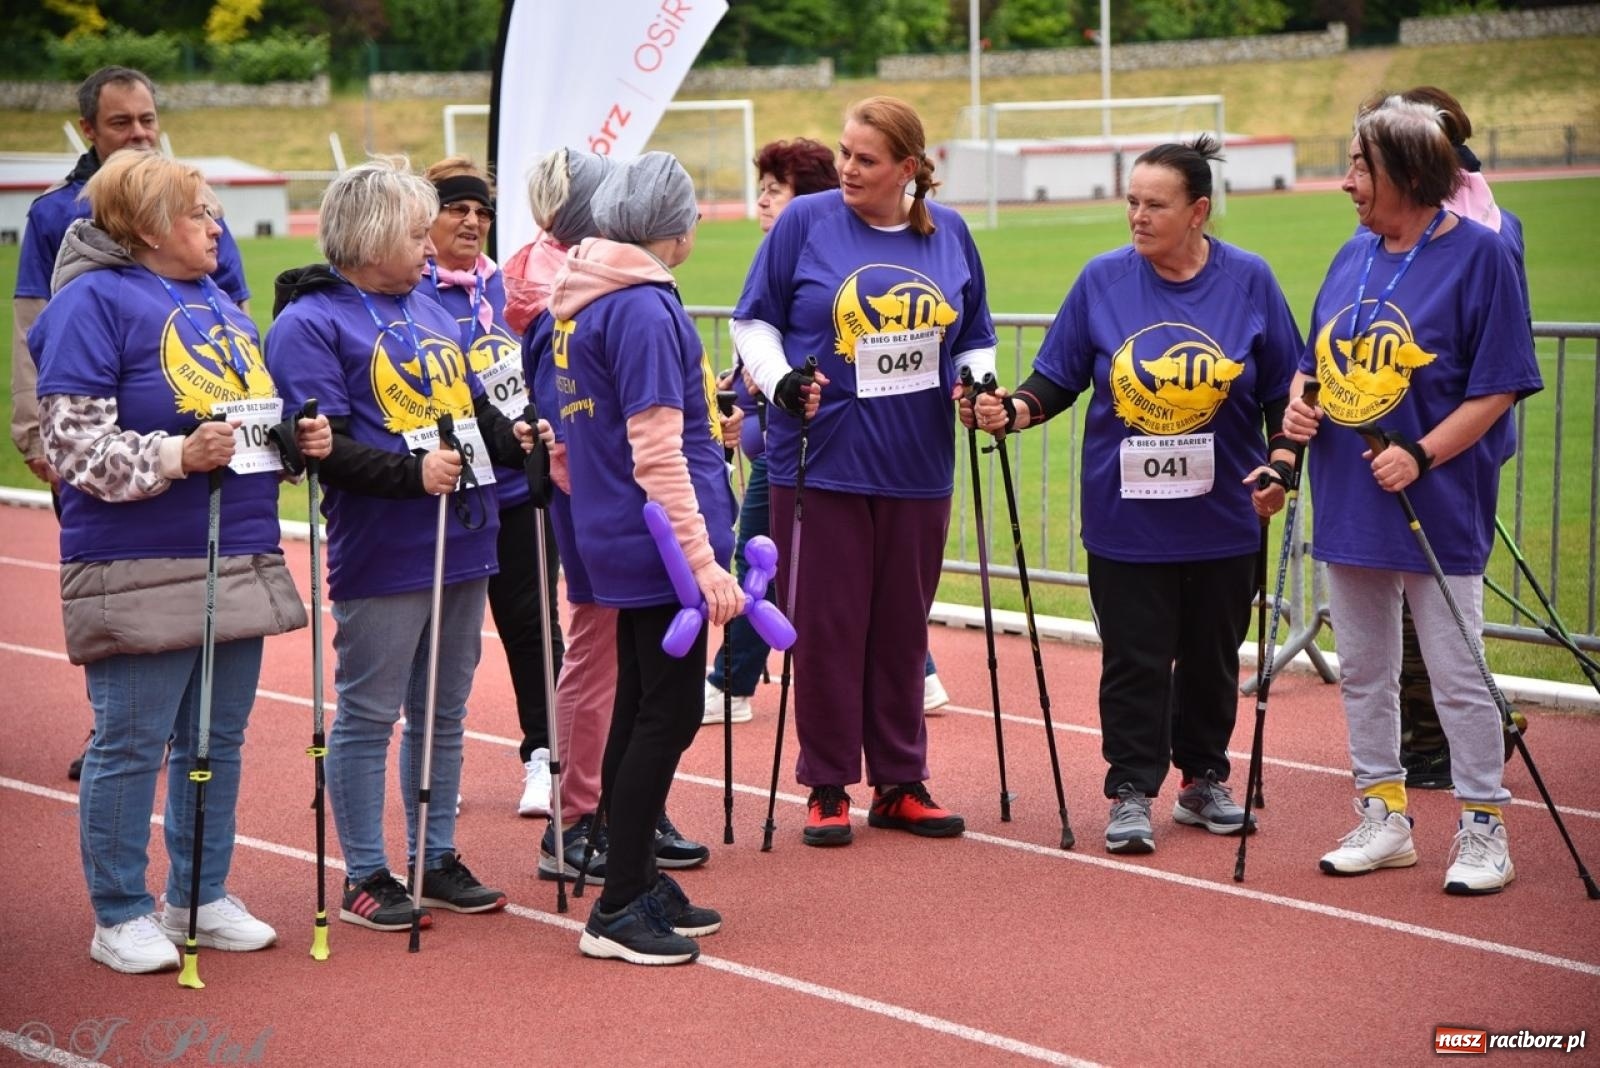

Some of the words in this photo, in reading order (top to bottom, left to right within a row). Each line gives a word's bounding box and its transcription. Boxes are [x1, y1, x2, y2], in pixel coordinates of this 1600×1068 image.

[588, 104, 632, 155] órz
[634, 0, 693, 72] OSiR
[896, 292, 937, 329] 10
[871, 336, 890, 344] BIEG
[893, 334, 907, 342] BEZ
[910, 332, 935, 341] BARIER
[877, 351, 923, 374] 049
[1365, 333, 1400, 372] 10
[1173, 353, 1215, 389] 10
[1319, 355, 1361, 406] RACIBORSKI
[494, 371, 525, 401] 02
[1117, 375, 1174, 420] RACIBORSKI
[227, 404, 245, 414] BIEG
[1346, 408, 1358, 418] BEZ
[240, 424, 270, 448] 105
[1145, 418, 1160, 431] BIEG
[1161, 421, 1175, 432] BEZ
[1137, 440, 1157, 448] BIEG
[1159, 439, 1175, 447] BEZ
[1177, 438, 1207, 446] BARIER
[1144, 457, 1189, 478] 041
